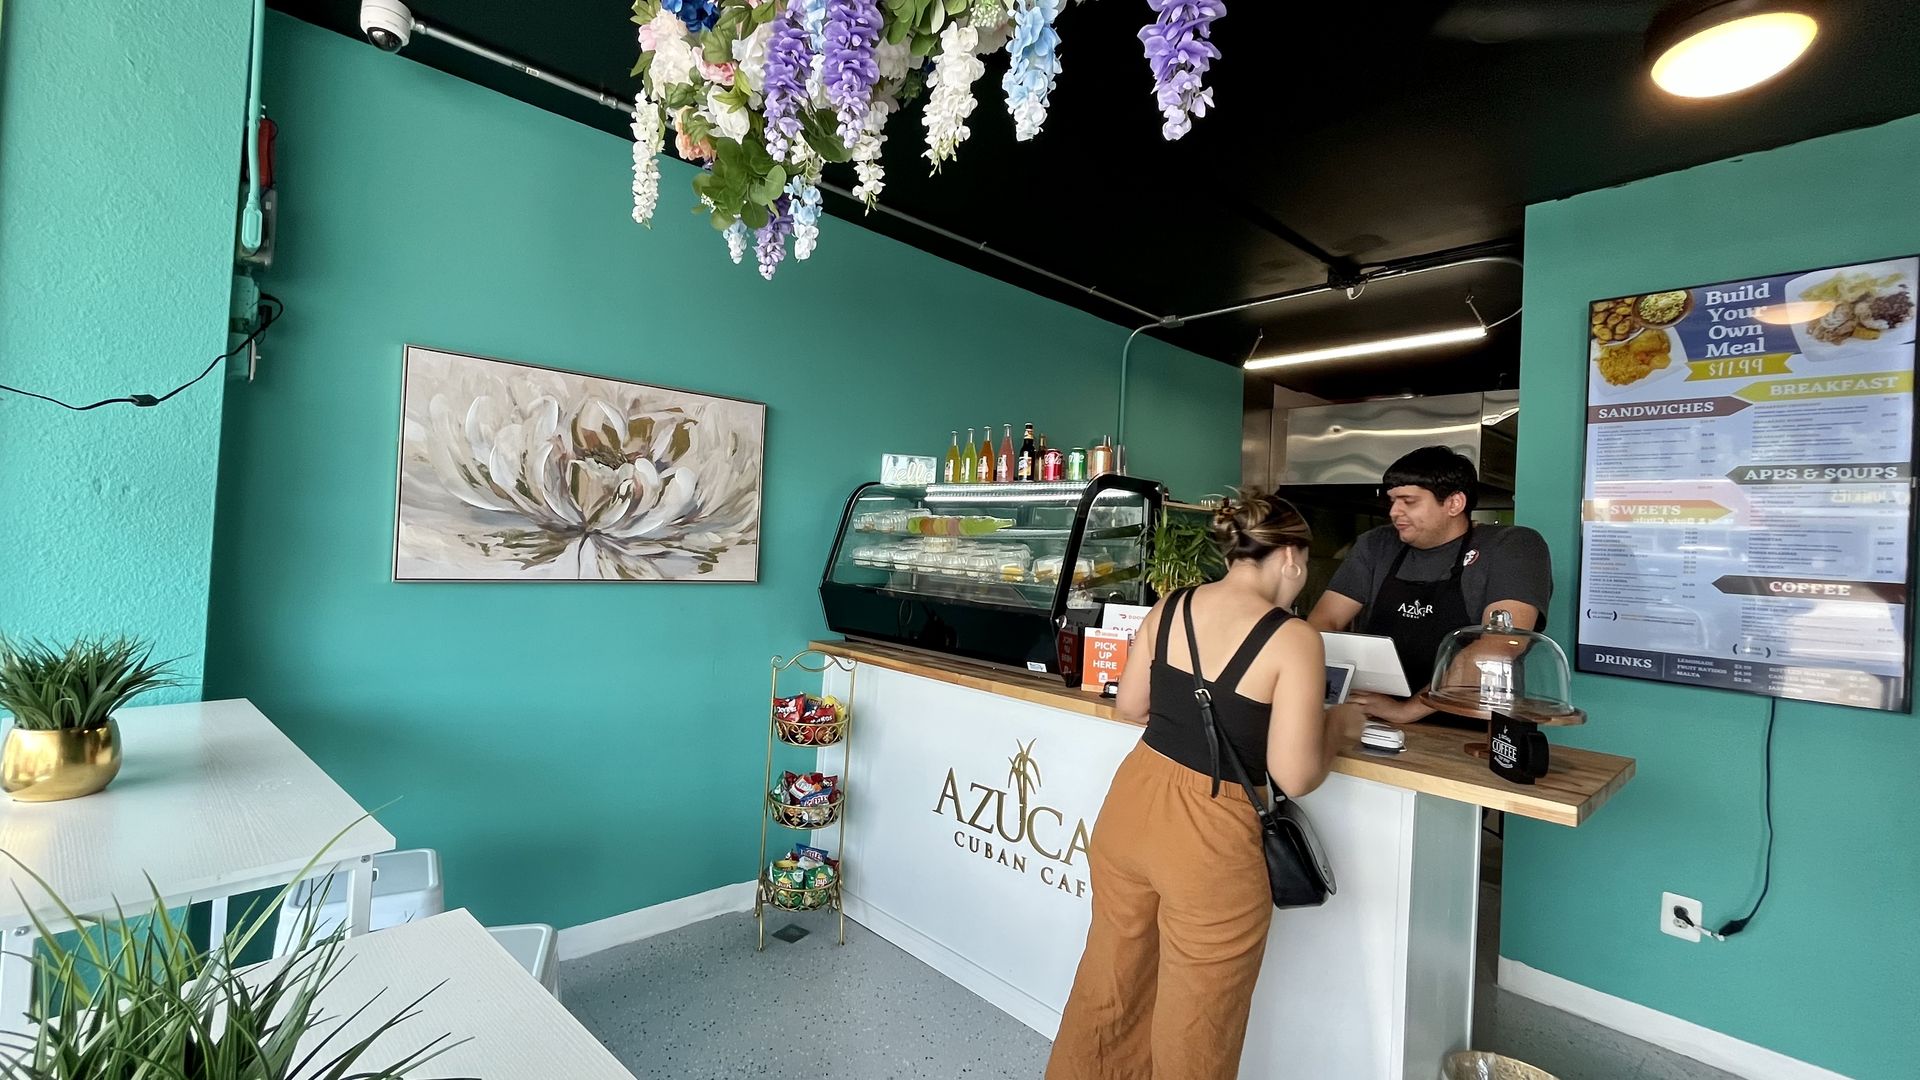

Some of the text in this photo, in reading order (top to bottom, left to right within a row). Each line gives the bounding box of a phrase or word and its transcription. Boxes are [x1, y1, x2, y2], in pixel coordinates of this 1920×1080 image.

[1705, 283, 1771, 306] Build
[1706, 306, 1768, 323] Your
[1709, 324, 1764, 340] Own
[1705, 337, 1766, 358] Meal
[1709, 358, 1763, 376] $11.99
[1770, 376, 1899, 396] BREAKFAST
[1598, 402, 1714, 419] SANDWICHES
[1744, 467, 1897, 481] APPS & SOUPS
[1610, 504, 1681, 516] SWEETS
[1769, 581, 1852, 596] COFFEE
[1094, 642, 1117, 651] PICK
[1093, 660, 1117, 669] HERE
[1595, 653, 1654, 669] DRINKS
[1492, 740, 1517, 760] COFFEE
[932, 766, 1092, 866] AZUCA
[954, 831, 1086, 898] CUBAN CAF
